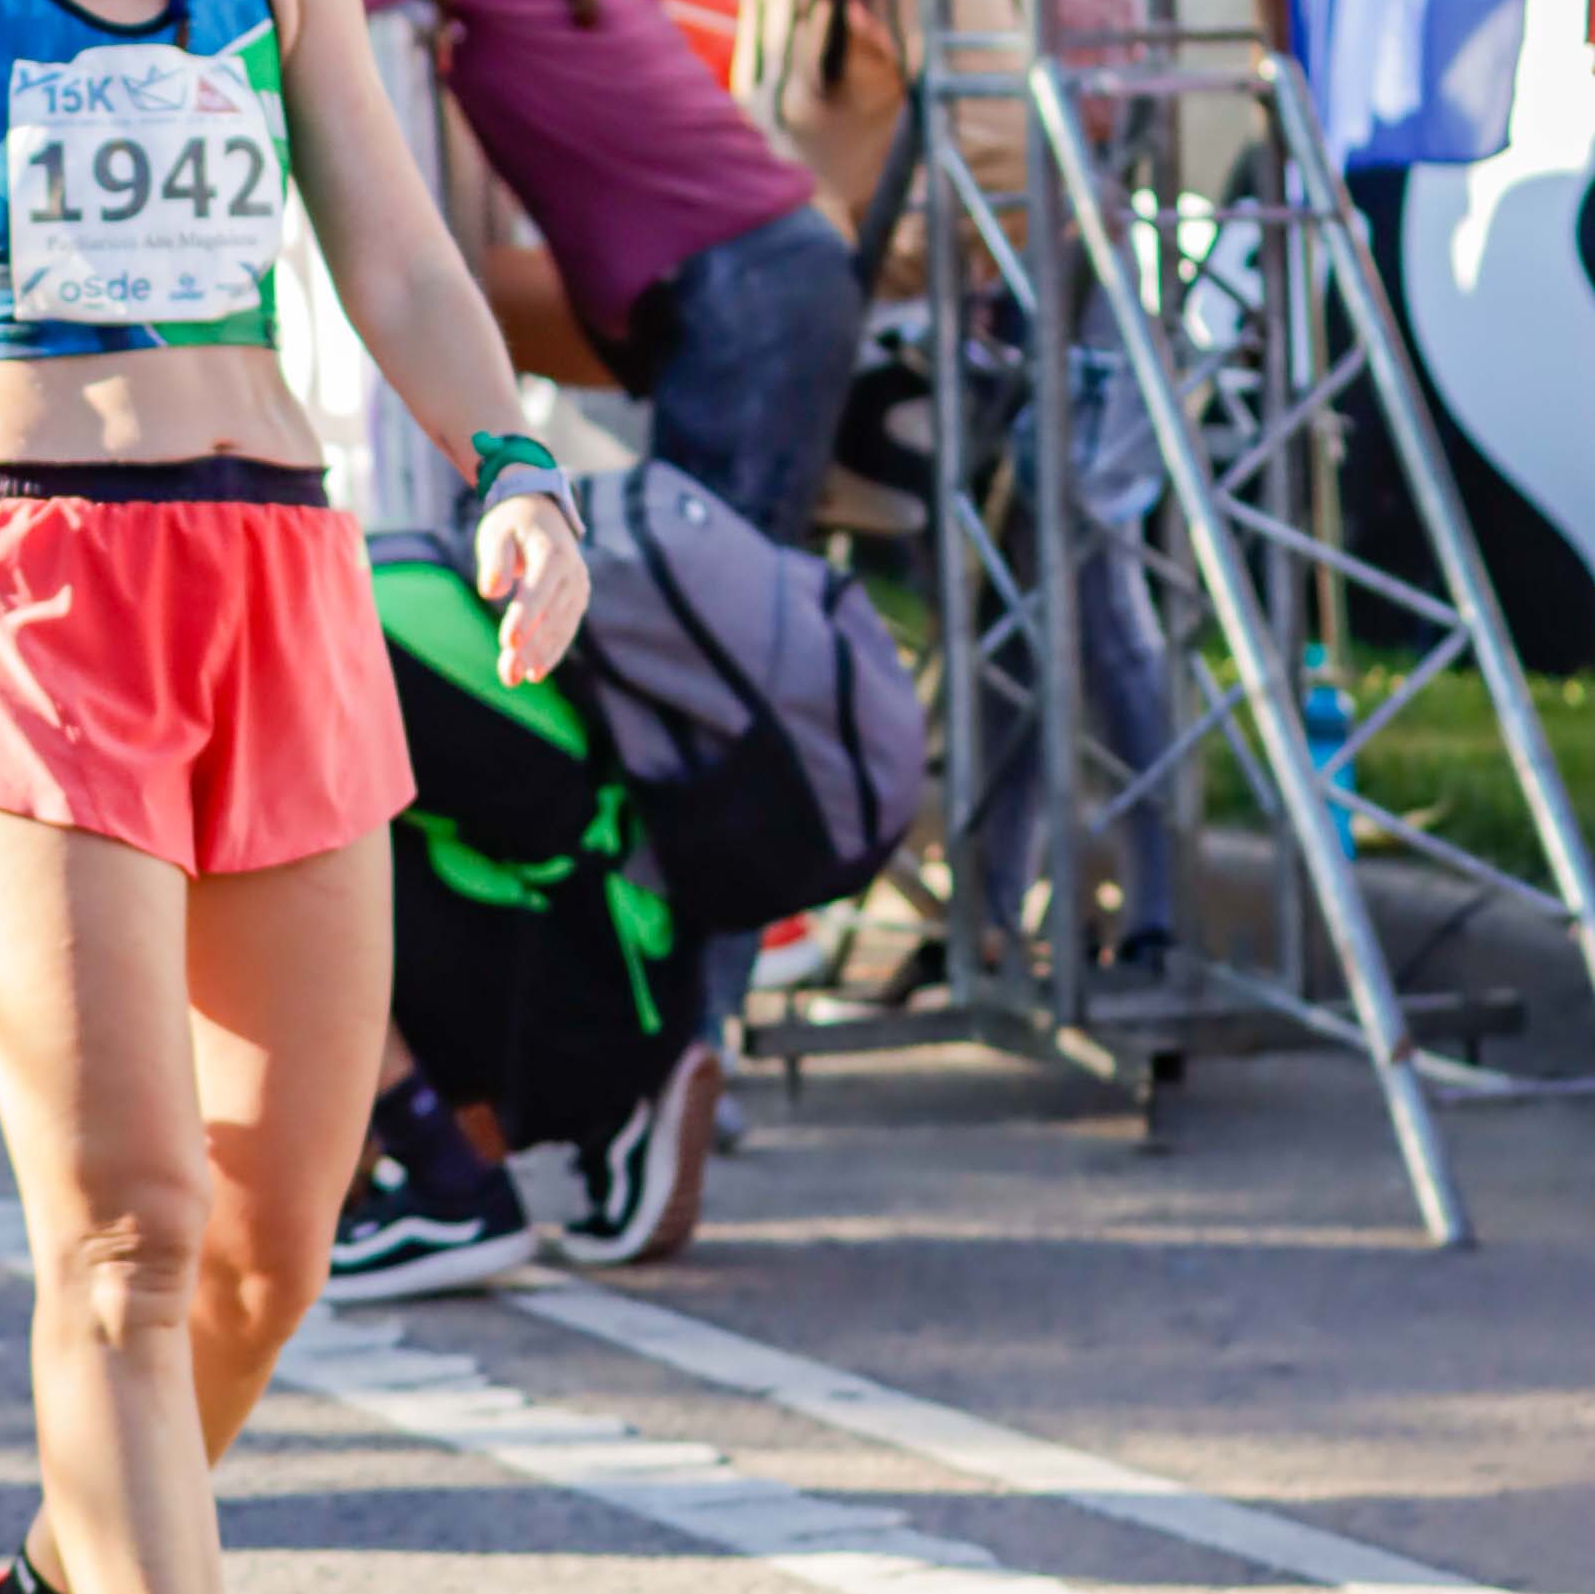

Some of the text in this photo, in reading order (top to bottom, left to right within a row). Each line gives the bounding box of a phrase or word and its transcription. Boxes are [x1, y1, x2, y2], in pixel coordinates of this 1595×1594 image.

[42, 76, 115, 114] 15K
[28, 137, 274, 223] 1942
[58, 271, 152, 309] osde
